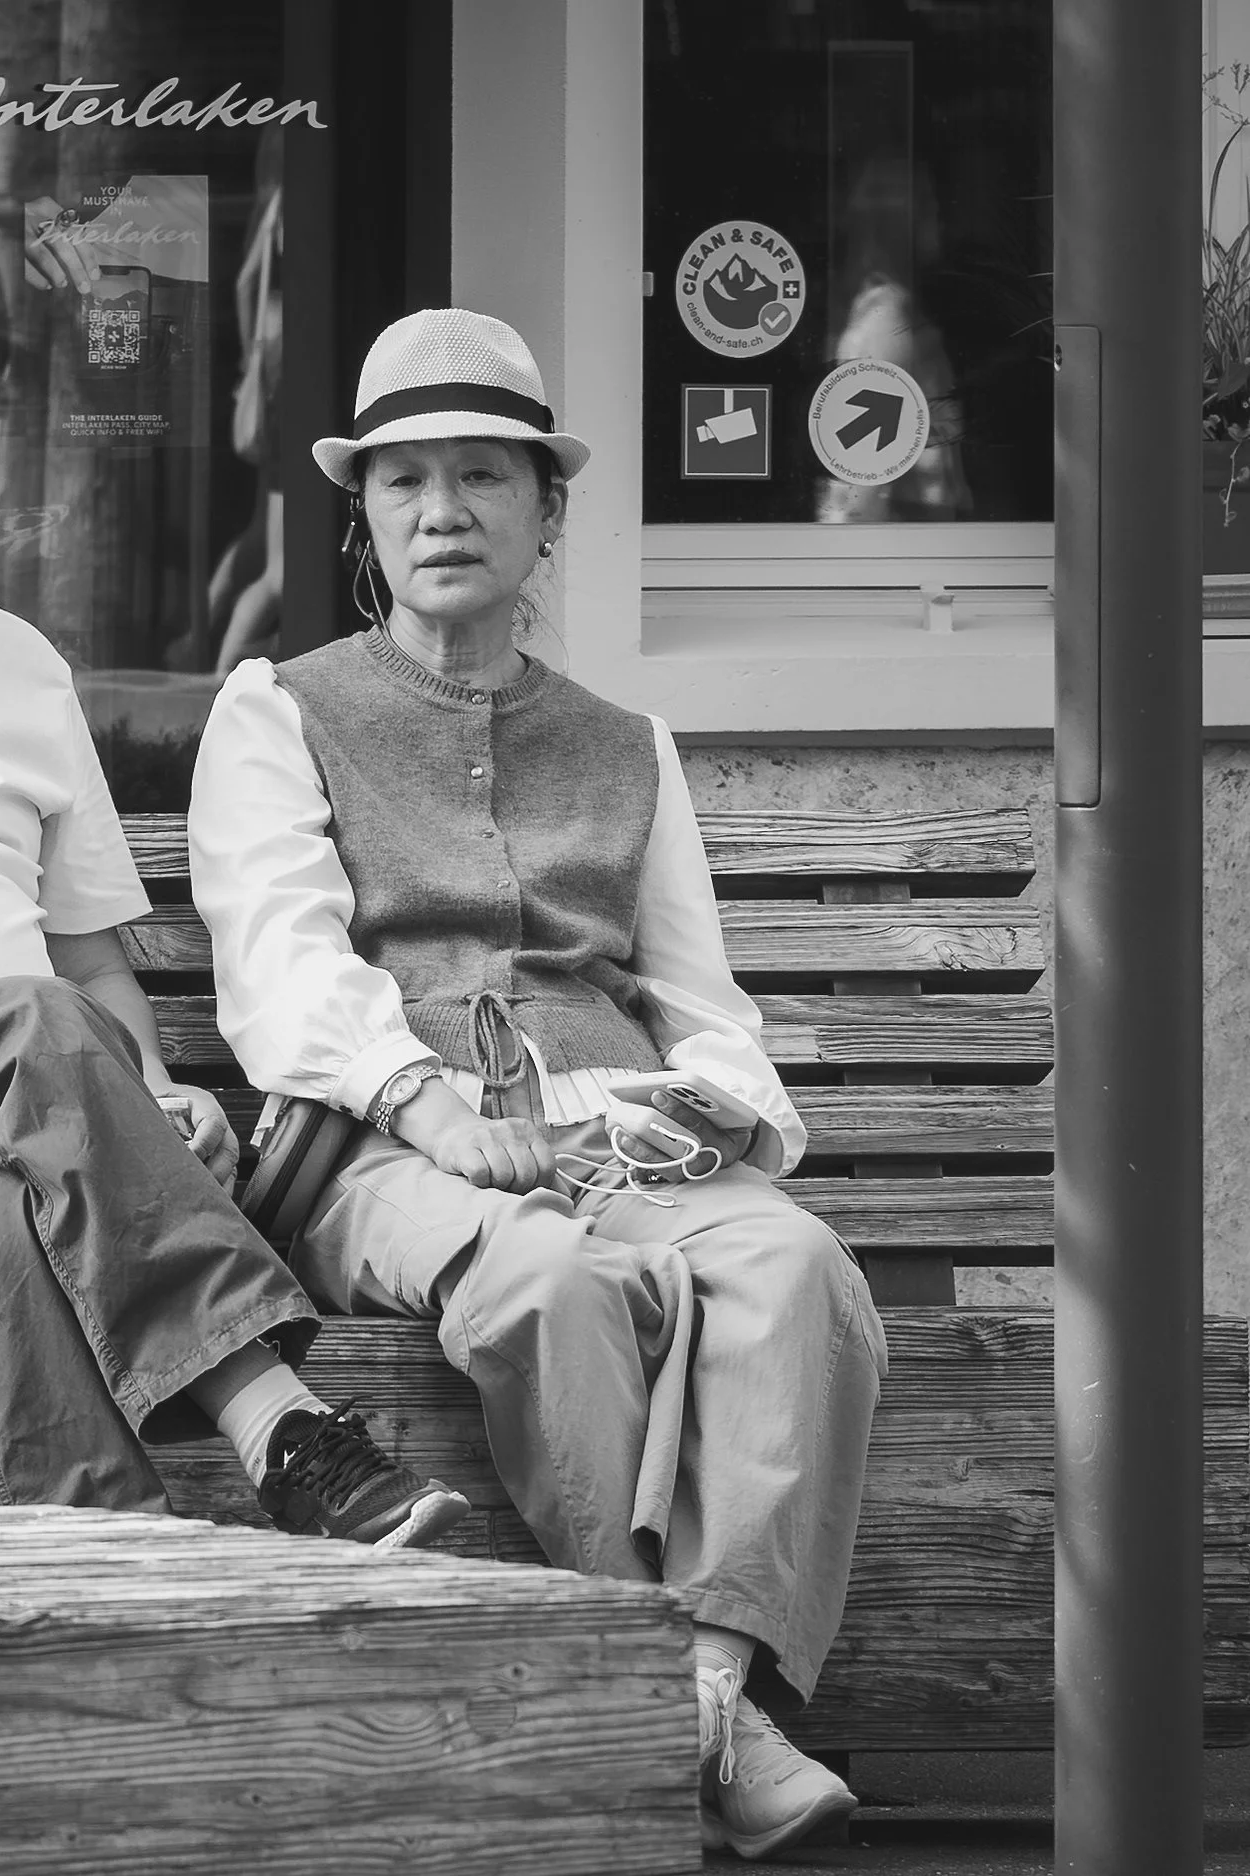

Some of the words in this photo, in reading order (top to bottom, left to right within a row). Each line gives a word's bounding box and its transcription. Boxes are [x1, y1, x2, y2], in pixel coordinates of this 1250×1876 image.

[100, 186, 133, 196] YOUR
[29, 220, 200, 248] Interlaken
[682, 232, 726, 296] CLEAN
[731, 228, 744, 243] &
[750, 231, 794, 274] SAFE
[687, 302, 764, 349] clean-and-safe.ch
[813, 367, 858, 420] Berufsbildung
[858, 363, 898, 379] Schweiz
[70, 414, 85, 422] THE
[87, 414, 136, 422] INTERLAKEN
[137, 414, 163, 422] GUIDE
[830, 458, 878, 481] Lehrbetrieb
[899, 436, 922, 468] machen
